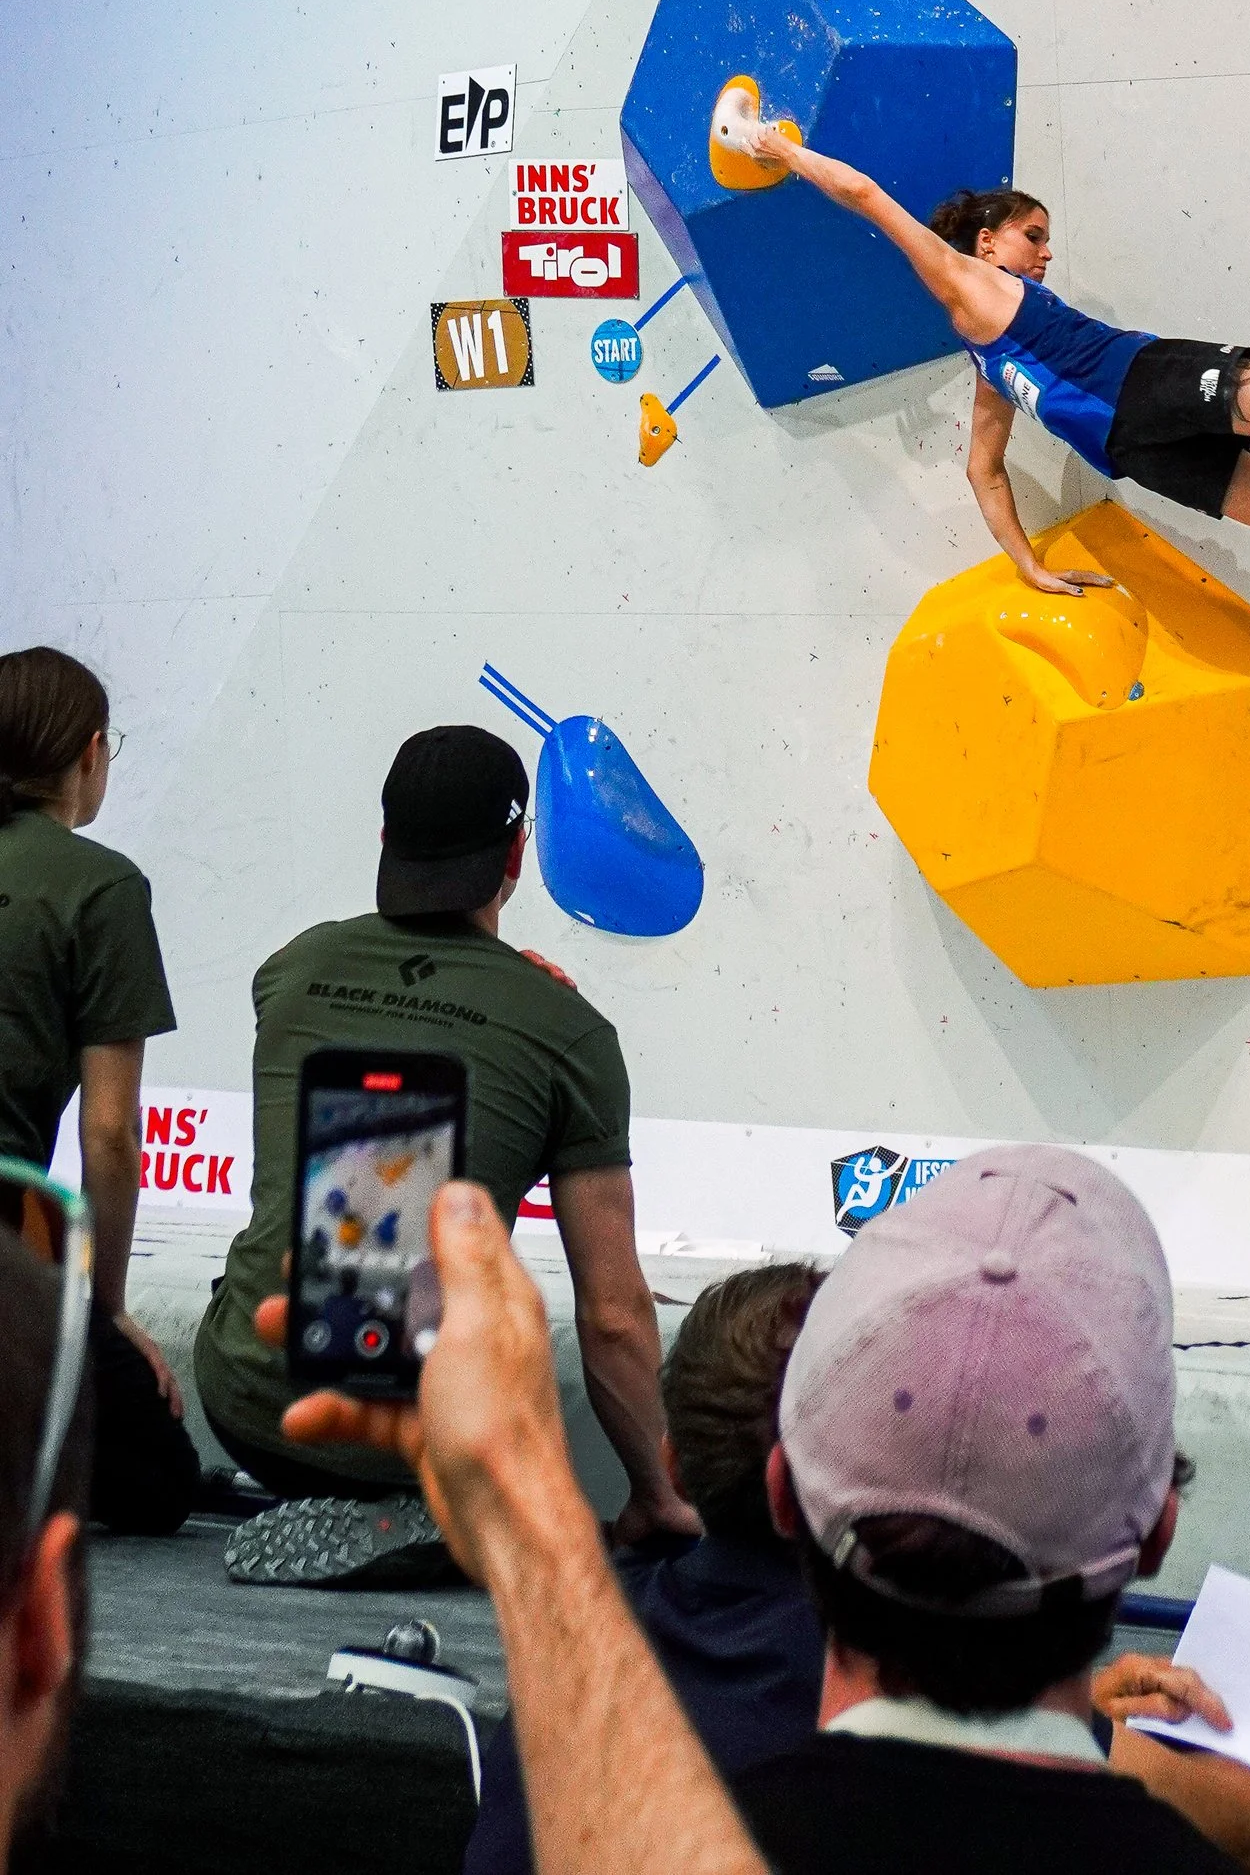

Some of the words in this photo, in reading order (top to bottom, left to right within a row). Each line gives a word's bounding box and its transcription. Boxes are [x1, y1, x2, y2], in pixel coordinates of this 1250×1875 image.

[516, 163, 597, 193] INNS'
[517, 196, 621, 226] BRUCK
[518, 241, 622, 288] Tirol
[447, 309, 509, 383] W1
[593, 336, 639, 363] START
[307, 982, 377, 1003] BLACK
[381, 992, 488, 1027] DIAMOND
